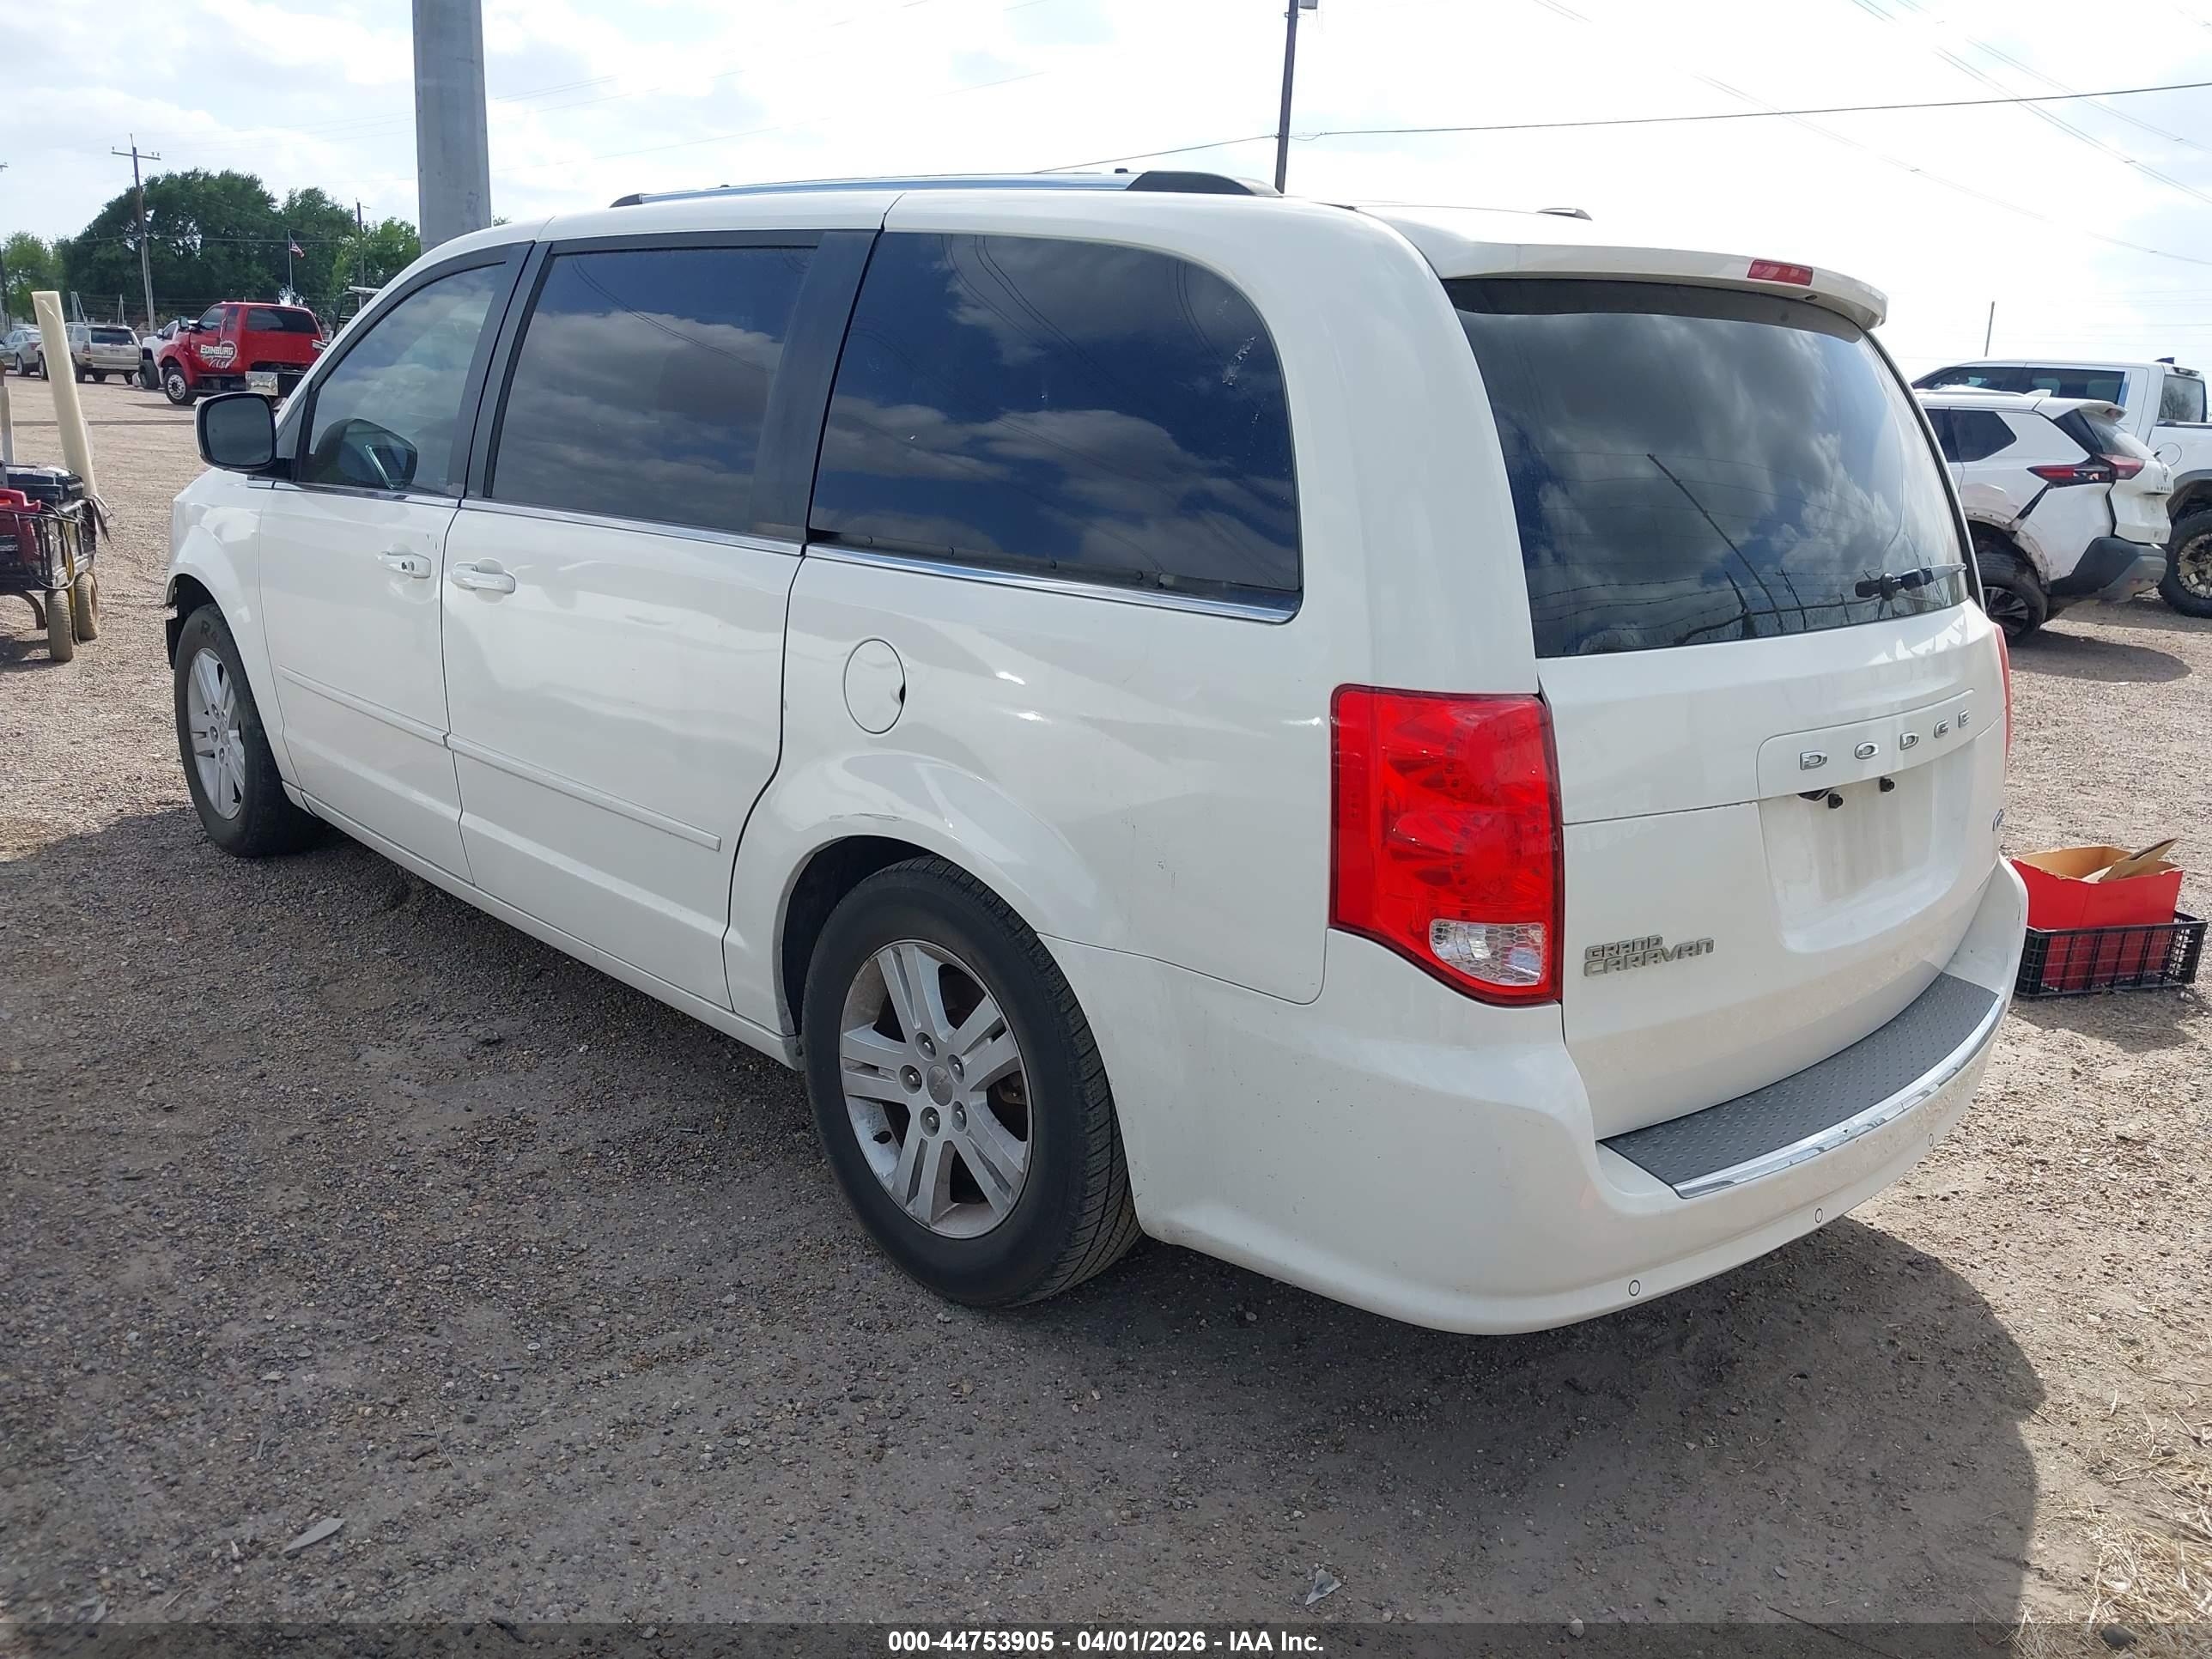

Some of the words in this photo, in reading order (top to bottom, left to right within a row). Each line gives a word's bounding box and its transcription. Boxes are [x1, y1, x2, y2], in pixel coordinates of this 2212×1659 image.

[1800, 709, 1970, 770] DODGE
[1583, 937, 1715, 977] CARAVAN
[1584, 934, 1663, 960] GRAND
